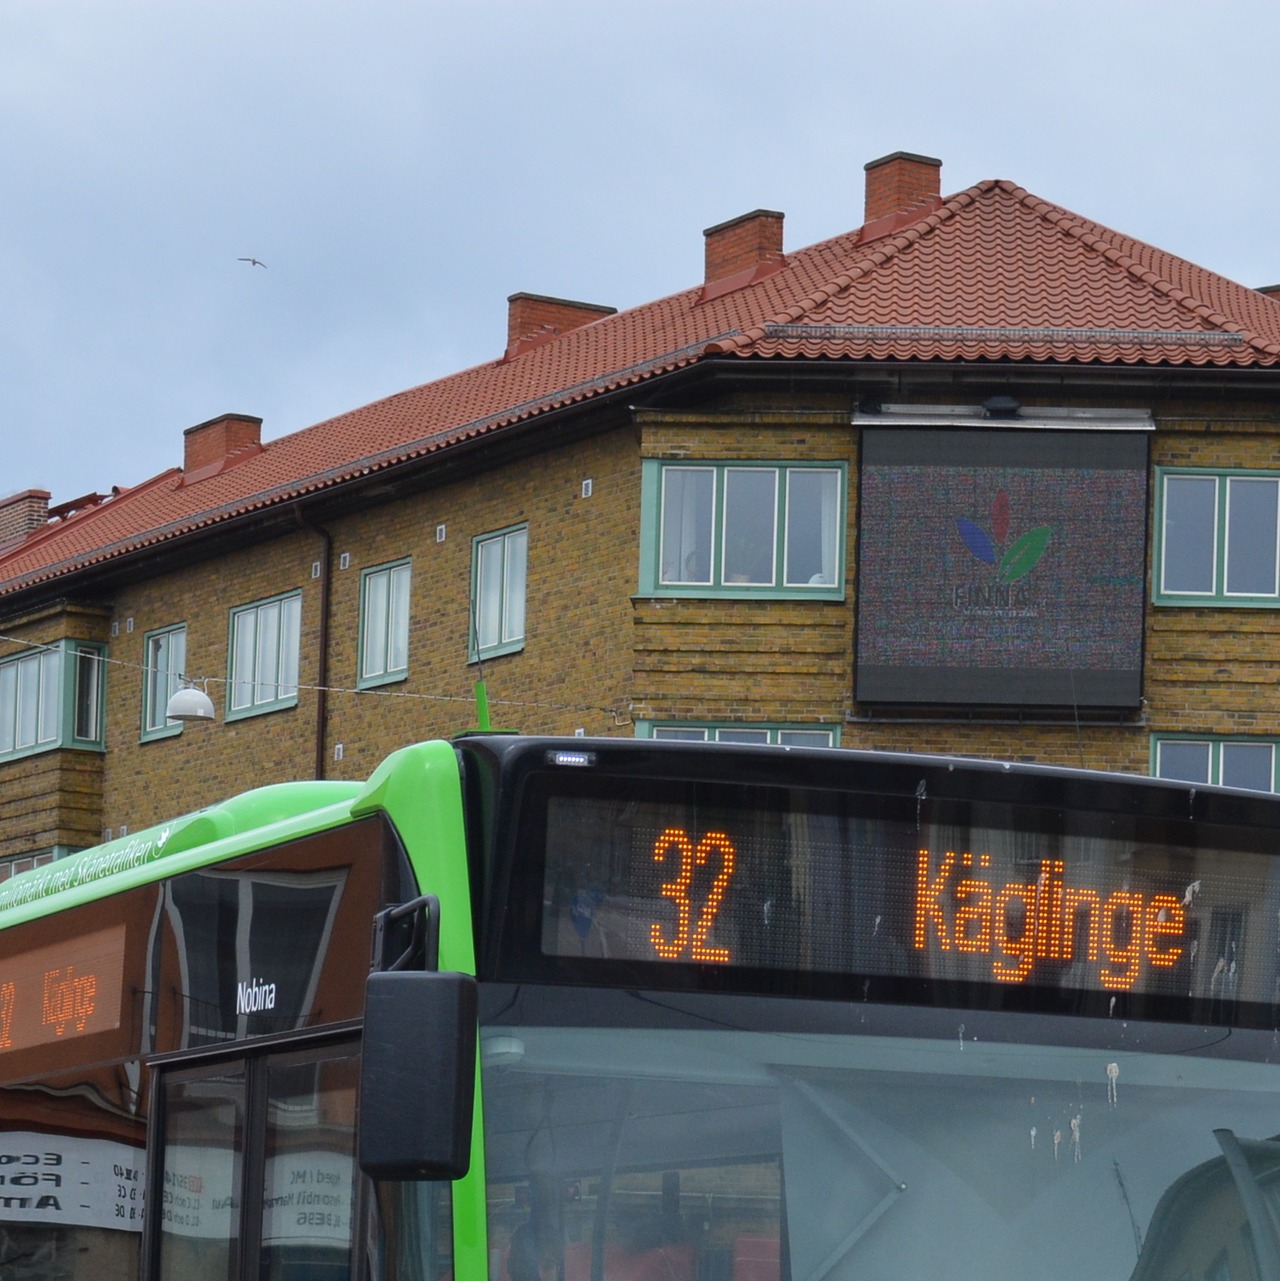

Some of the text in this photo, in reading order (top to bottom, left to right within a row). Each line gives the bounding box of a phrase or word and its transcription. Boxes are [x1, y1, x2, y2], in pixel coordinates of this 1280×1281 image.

[49, 859, 80, 894] med
[74, 839, 153, 886] Skånetrafiken
[650, 828, 1185, 989] 32 Käglinge
[236, 977, 276, 1015] Nobina
